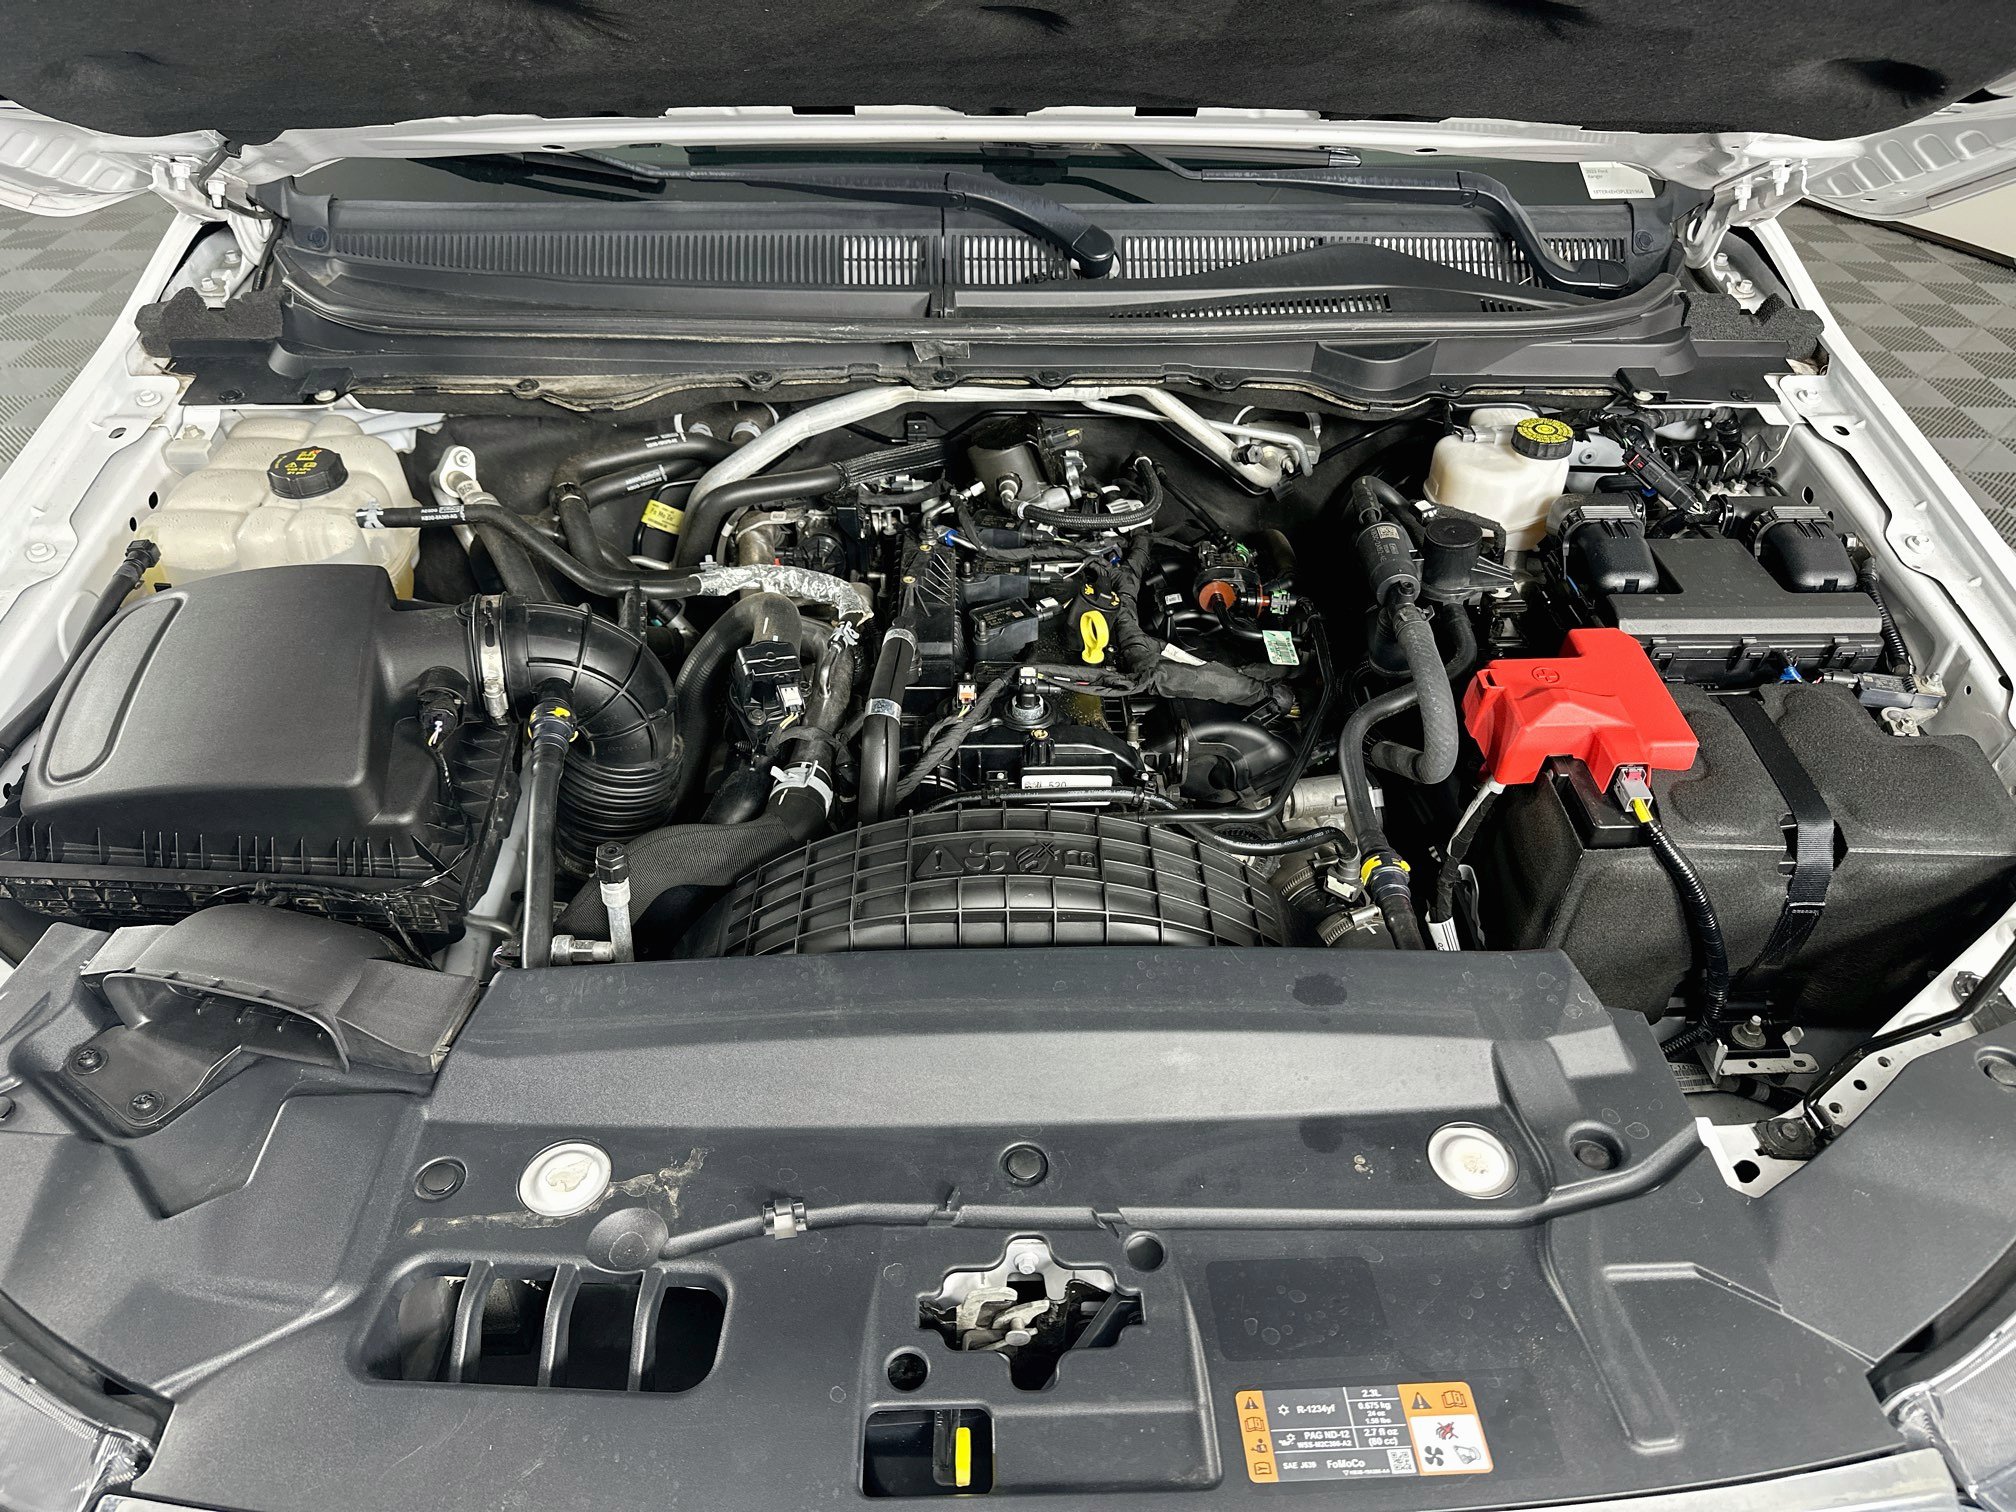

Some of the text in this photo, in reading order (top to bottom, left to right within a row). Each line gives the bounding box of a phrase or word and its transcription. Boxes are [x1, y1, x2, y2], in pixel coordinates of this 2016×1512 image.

[1361, 1389, 1382, 1398] 2.3L
[1296, 1404, 1336, 1415] R-1234yf
[1380, 1401, 1392, 1411] kg
[1303, 1430, 1351, 1441] PAG ND-12
[1363, 1428, 1377, 1437] 2.7
[1386, 1428, 1400, 1436] oz
[1383, 1436, 1398, 1447] cc)
[1282, 1461, 1299, 1470] SAE
[1326, 1459, 1366, 1470] FoMoCo
